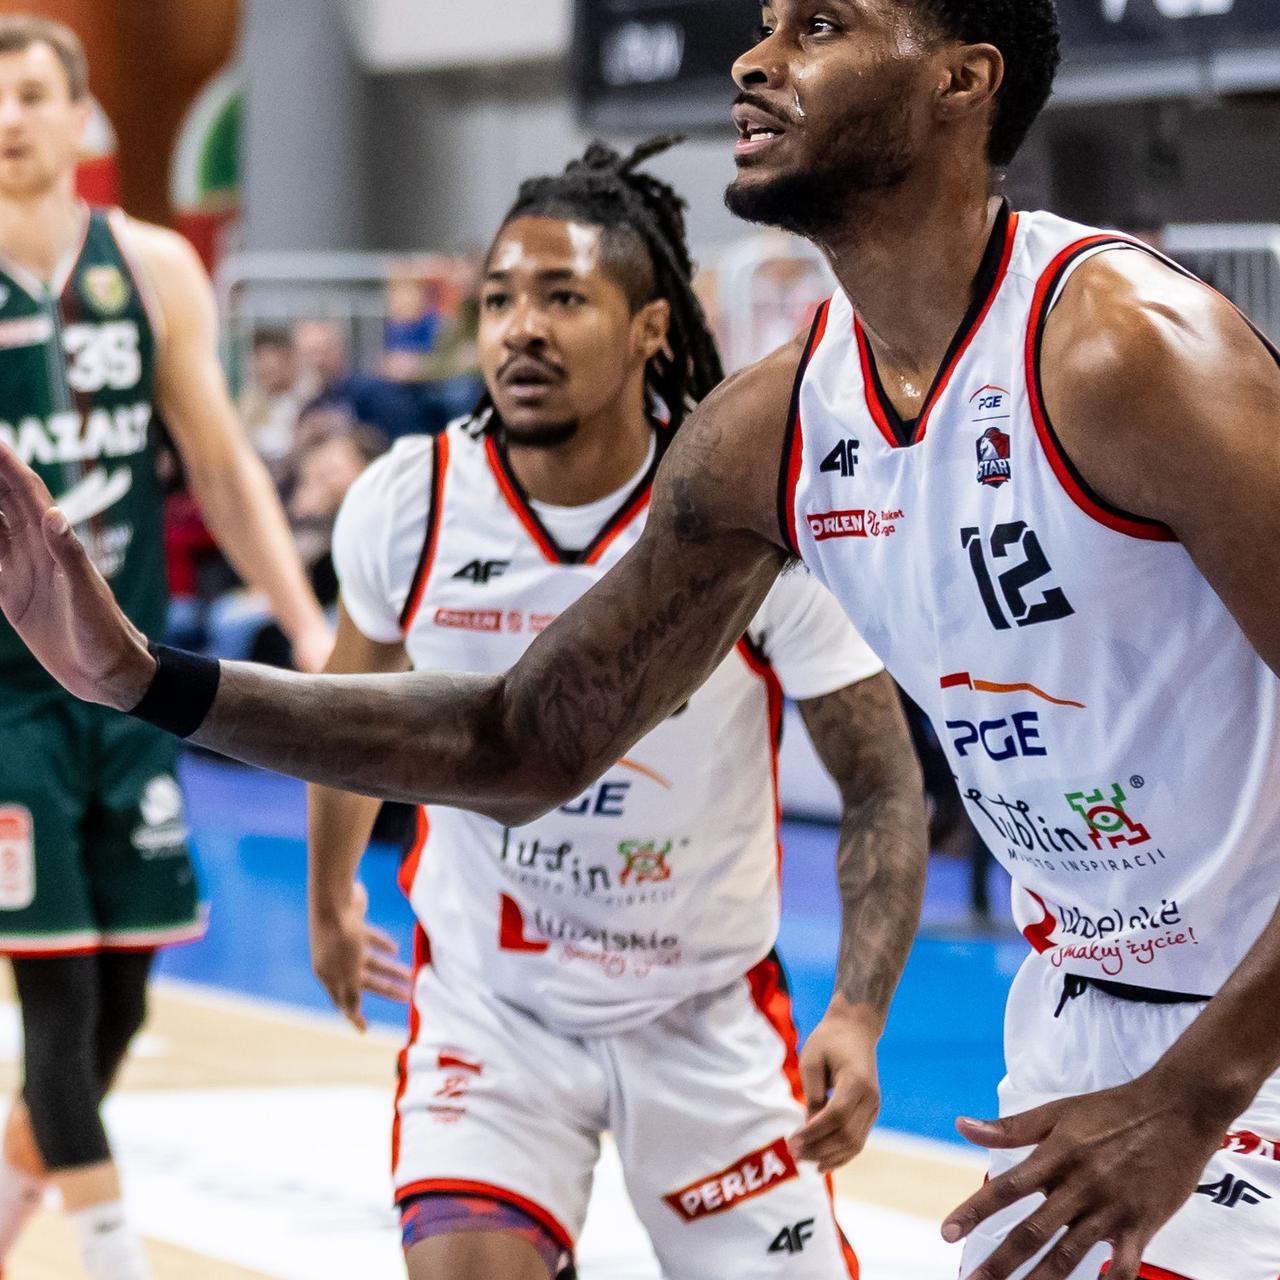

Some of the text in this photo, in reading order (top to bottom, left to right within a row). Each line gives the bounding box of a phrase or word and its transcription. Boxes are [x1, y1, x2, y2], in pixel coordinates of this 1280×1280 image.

[977, 394, 1003, 411] PGE
[819, 438, 861, 478] 4F
[810, 514, 864, 537] ORLEN
[450, 558, 511, 584] 4F
[960, 520, 1076, 631] 12
[946, 711, 1048, 762] PGE
[1125, 926, 1199, 965] życie!
[678, 1148, 788, 1217] PERŁA
[1194, 1172, 1273, 1209] 4F
[765, 1217, 816, 1255] 4F
